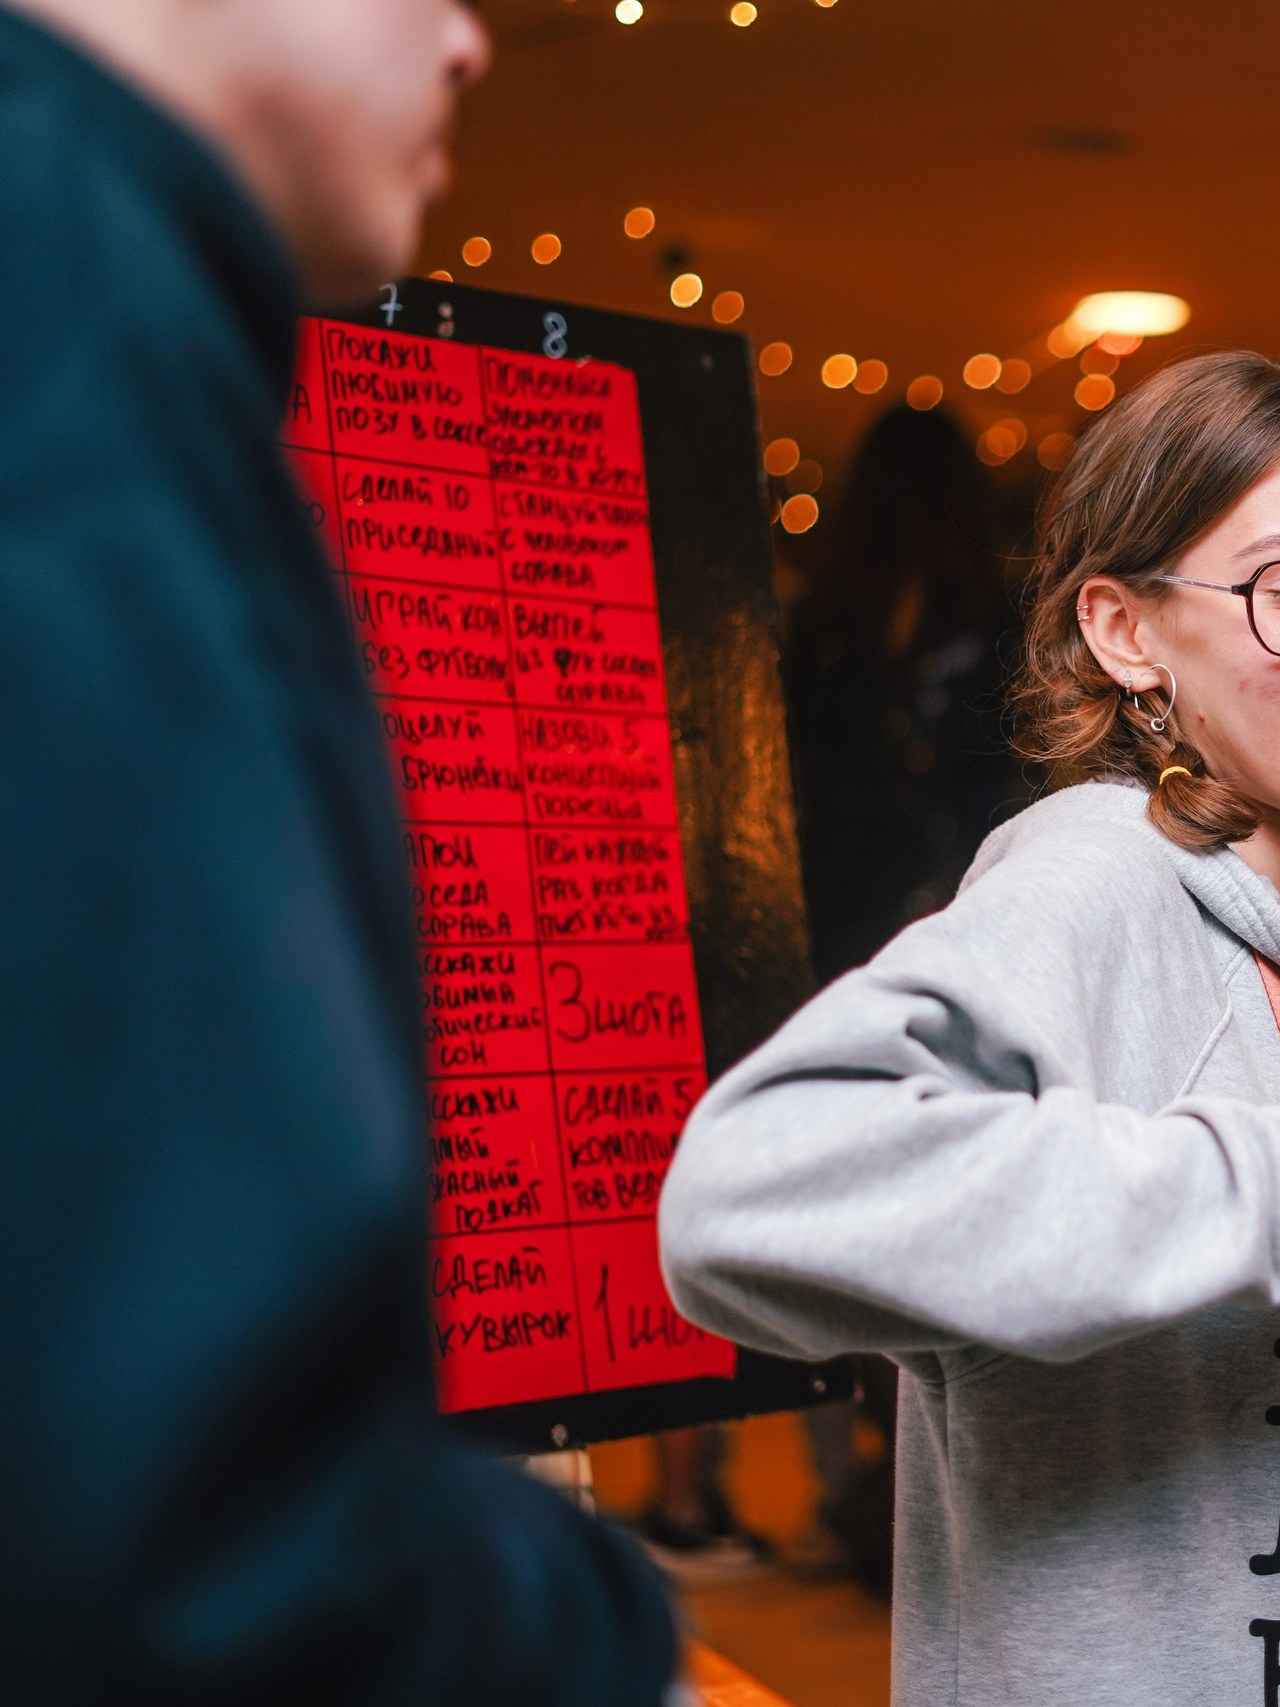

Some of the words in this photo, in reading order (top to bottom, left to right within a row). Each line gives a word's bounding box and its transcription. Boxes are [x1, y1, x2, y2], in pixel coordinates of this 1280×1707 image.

[542, 311, 568, 359] 8
[336, 406, 399, 435] ПОЗУ
[444, 481, 471, 512] 10
[383, 709, 485, 746] ОЦЕЛУЙ
[412, 879, 489, 908] ОСЕДА
[423, 951, 516, 977] ССКАЖИ
